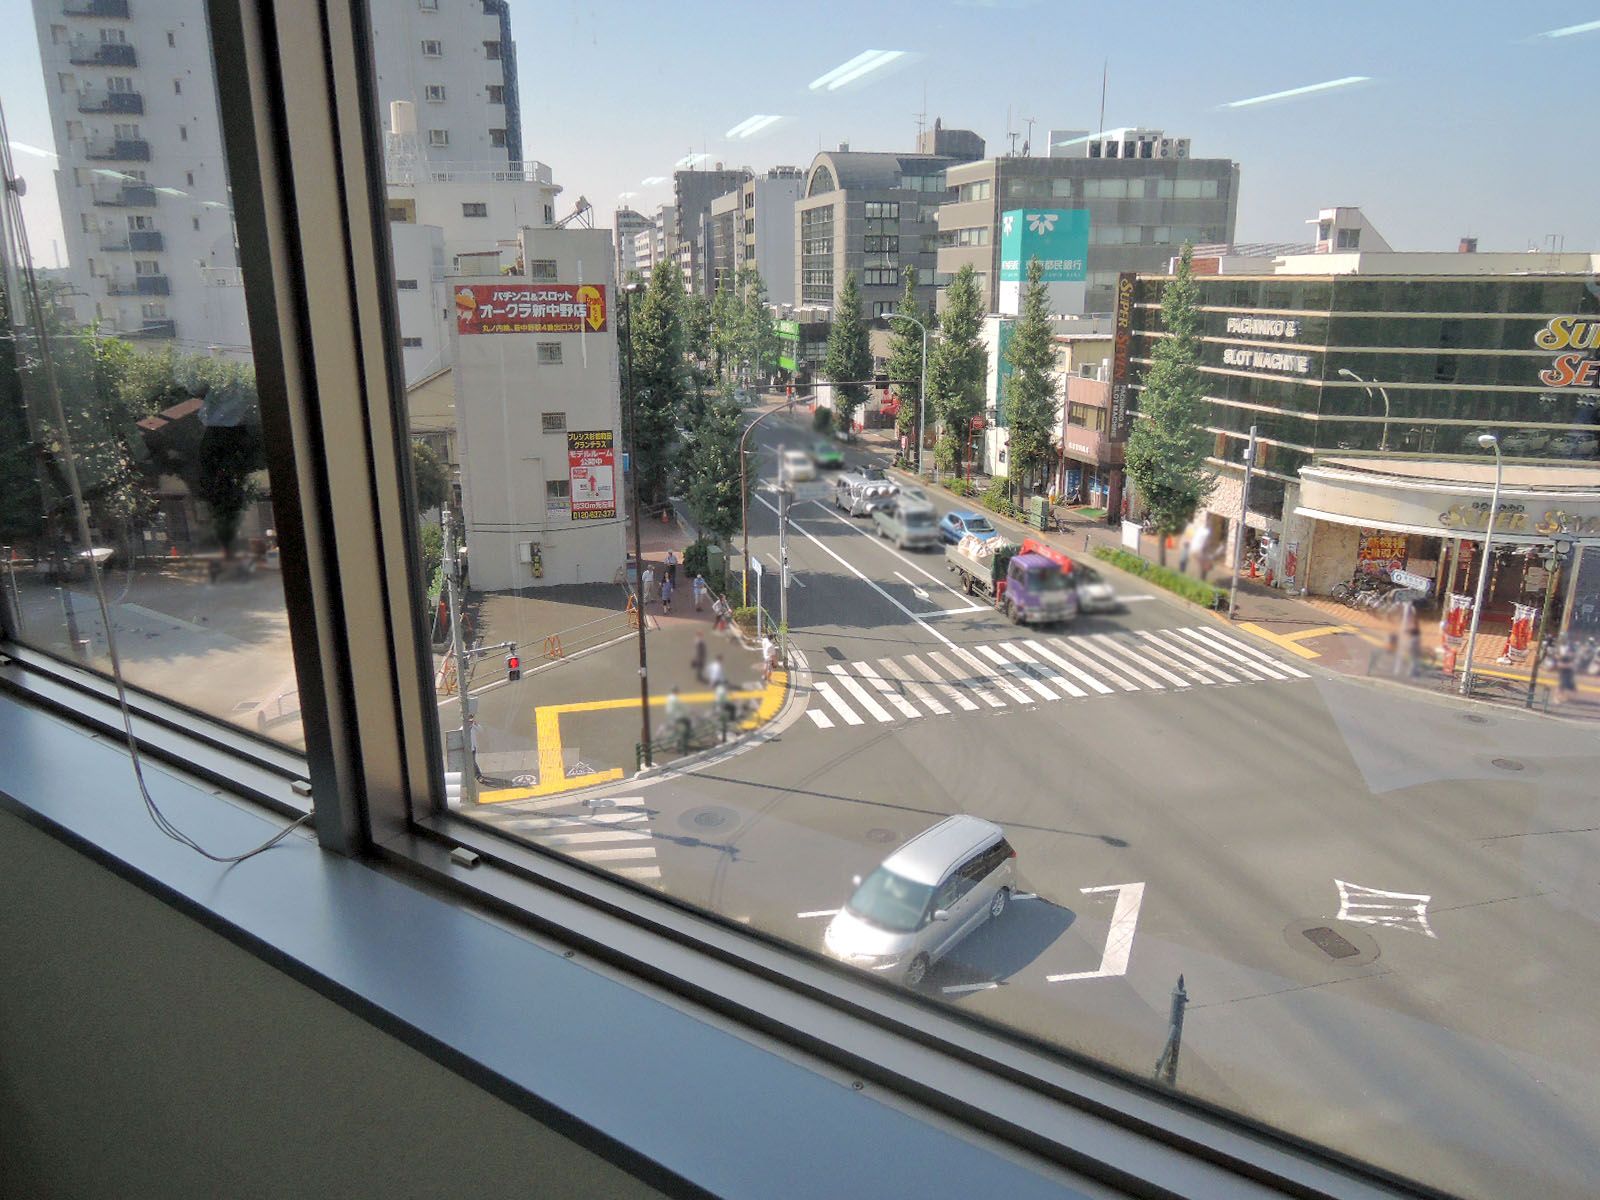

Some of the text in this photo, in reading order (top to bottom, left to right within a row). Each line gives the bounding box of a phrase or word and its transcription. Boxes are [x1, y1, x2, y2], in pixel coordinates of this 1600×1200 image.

[493, 291, 573, 302] パチンコ&スロット
[1118, 278, 1133, 328] SUPER
[1227, 317, 1298, 337] PACHINKO &
[1223, 348, 1309, 373] SLOT MACHINE
[569, 449, 613, 458] モデルルーム
